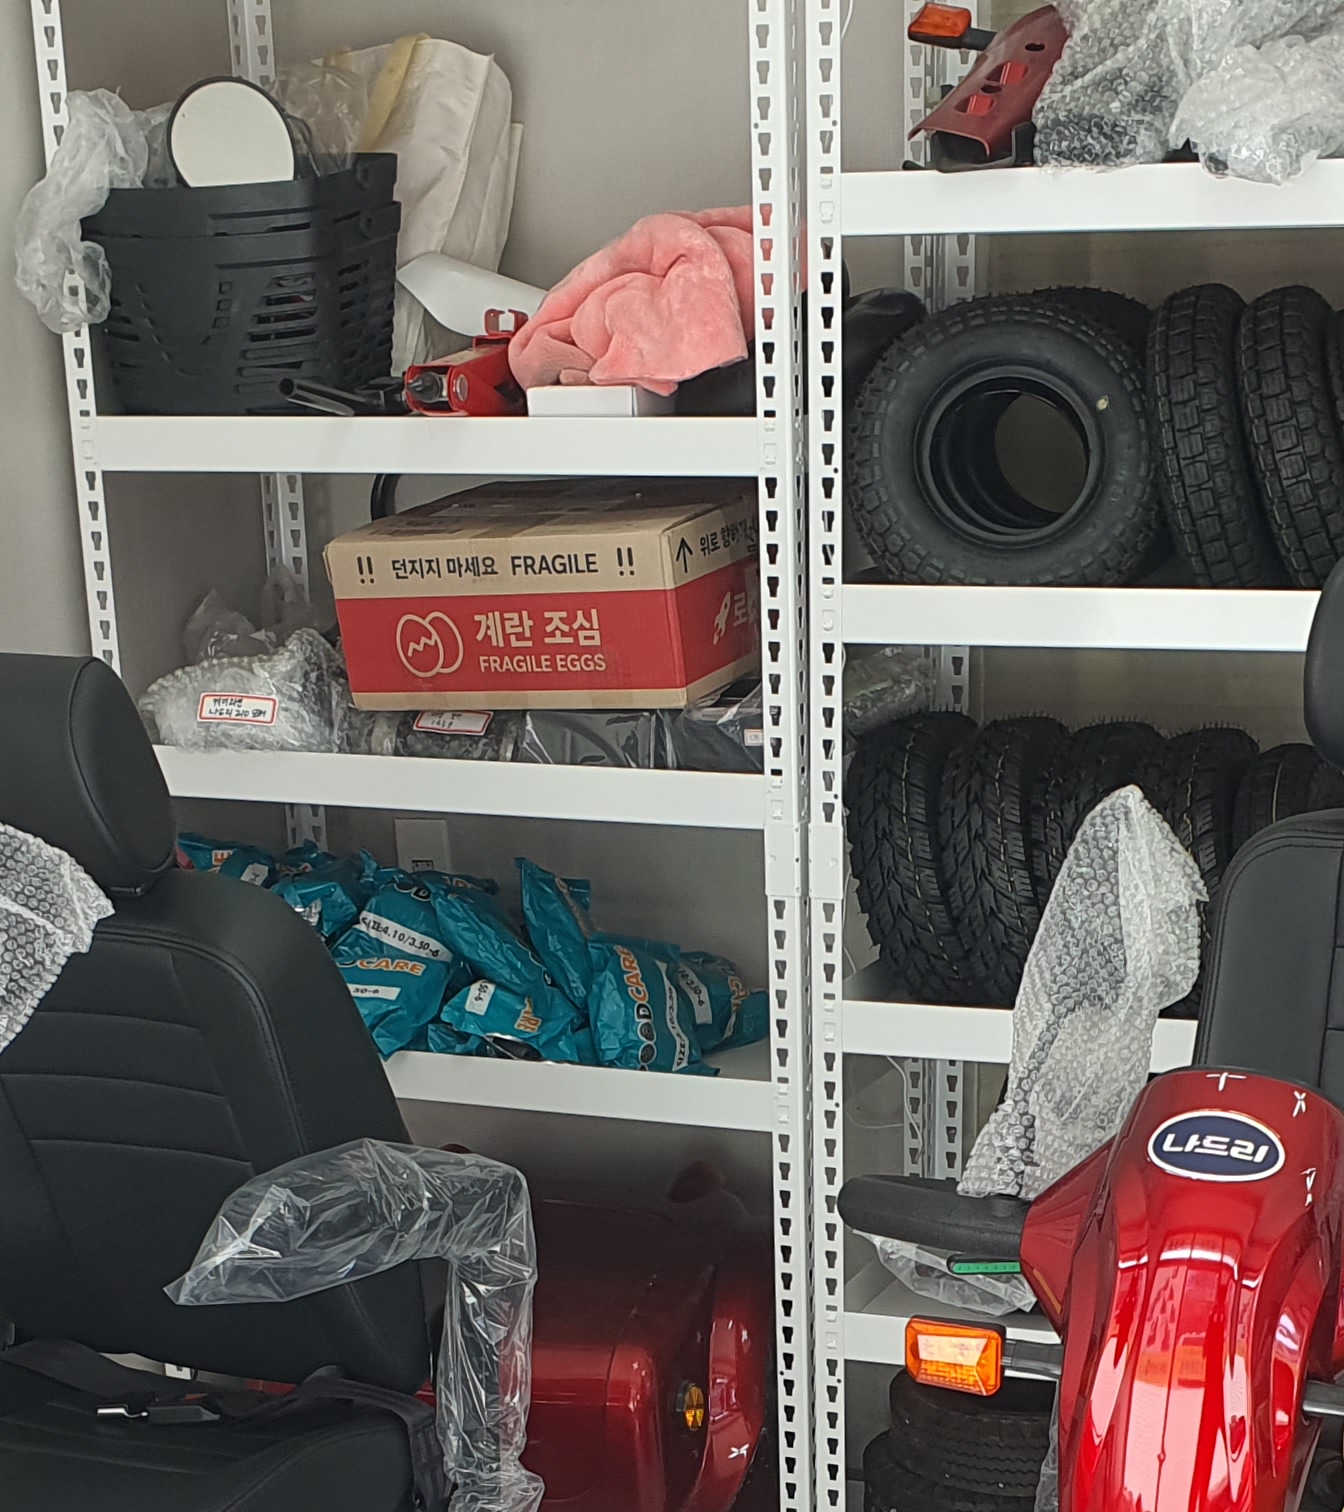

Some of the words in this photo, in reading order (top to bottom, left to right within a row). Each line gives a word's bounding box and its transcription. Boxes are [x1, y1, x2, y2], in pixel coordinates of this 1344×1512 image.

[699, 531, 720, 557] 위로
[392, 557, 442, 580] 던지지
[446, 555, 499, 578] 마세요
[510, 553, 599, 577] FRAGILE
[473, 610, 534, 648] 계란
[543, 608, 602, 647] 조심
[479, 655, 553, 673] FRAGILE
[556, 653, 607, 672] EGGS
[354, 957, 427, 976] CARE
[1161, 1133, 1270, 1163] 나드리
